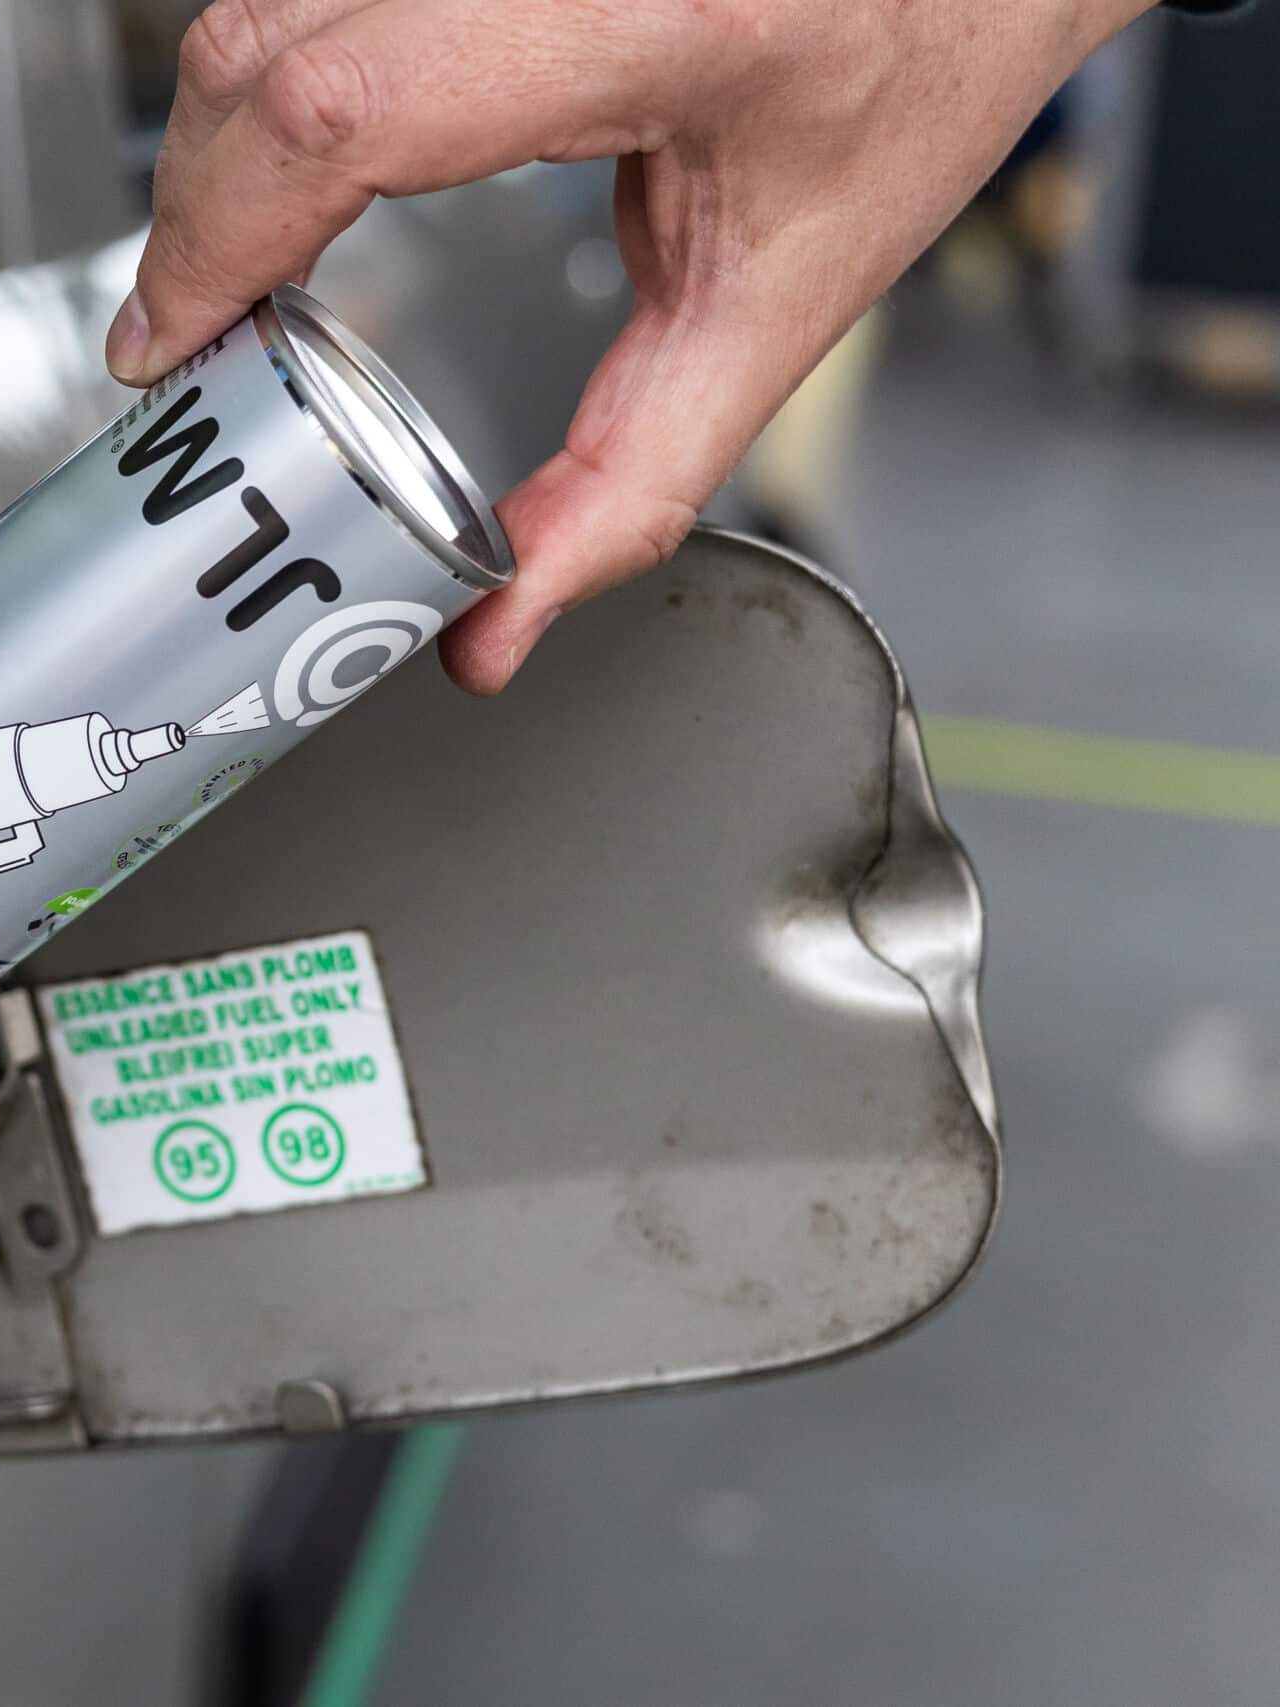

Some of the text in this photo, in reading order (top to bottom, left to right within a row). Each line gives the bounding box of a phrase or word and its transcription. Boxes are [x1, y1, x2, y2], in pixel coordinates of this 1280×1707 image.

[118, 386, 341, 632] JLM
[54, 945, 357, 1020] ESSENCE SANS PLOMB
[64, 983, 361, 1055] UNLEADED FUEL ONLY
[114, 1024, 331, 1083] BLEIFREI SUPER
[90, 1056, 377, 1125] GASOLINA SIN PLOMO
[169, 1126, 331, 1182] 95 98
